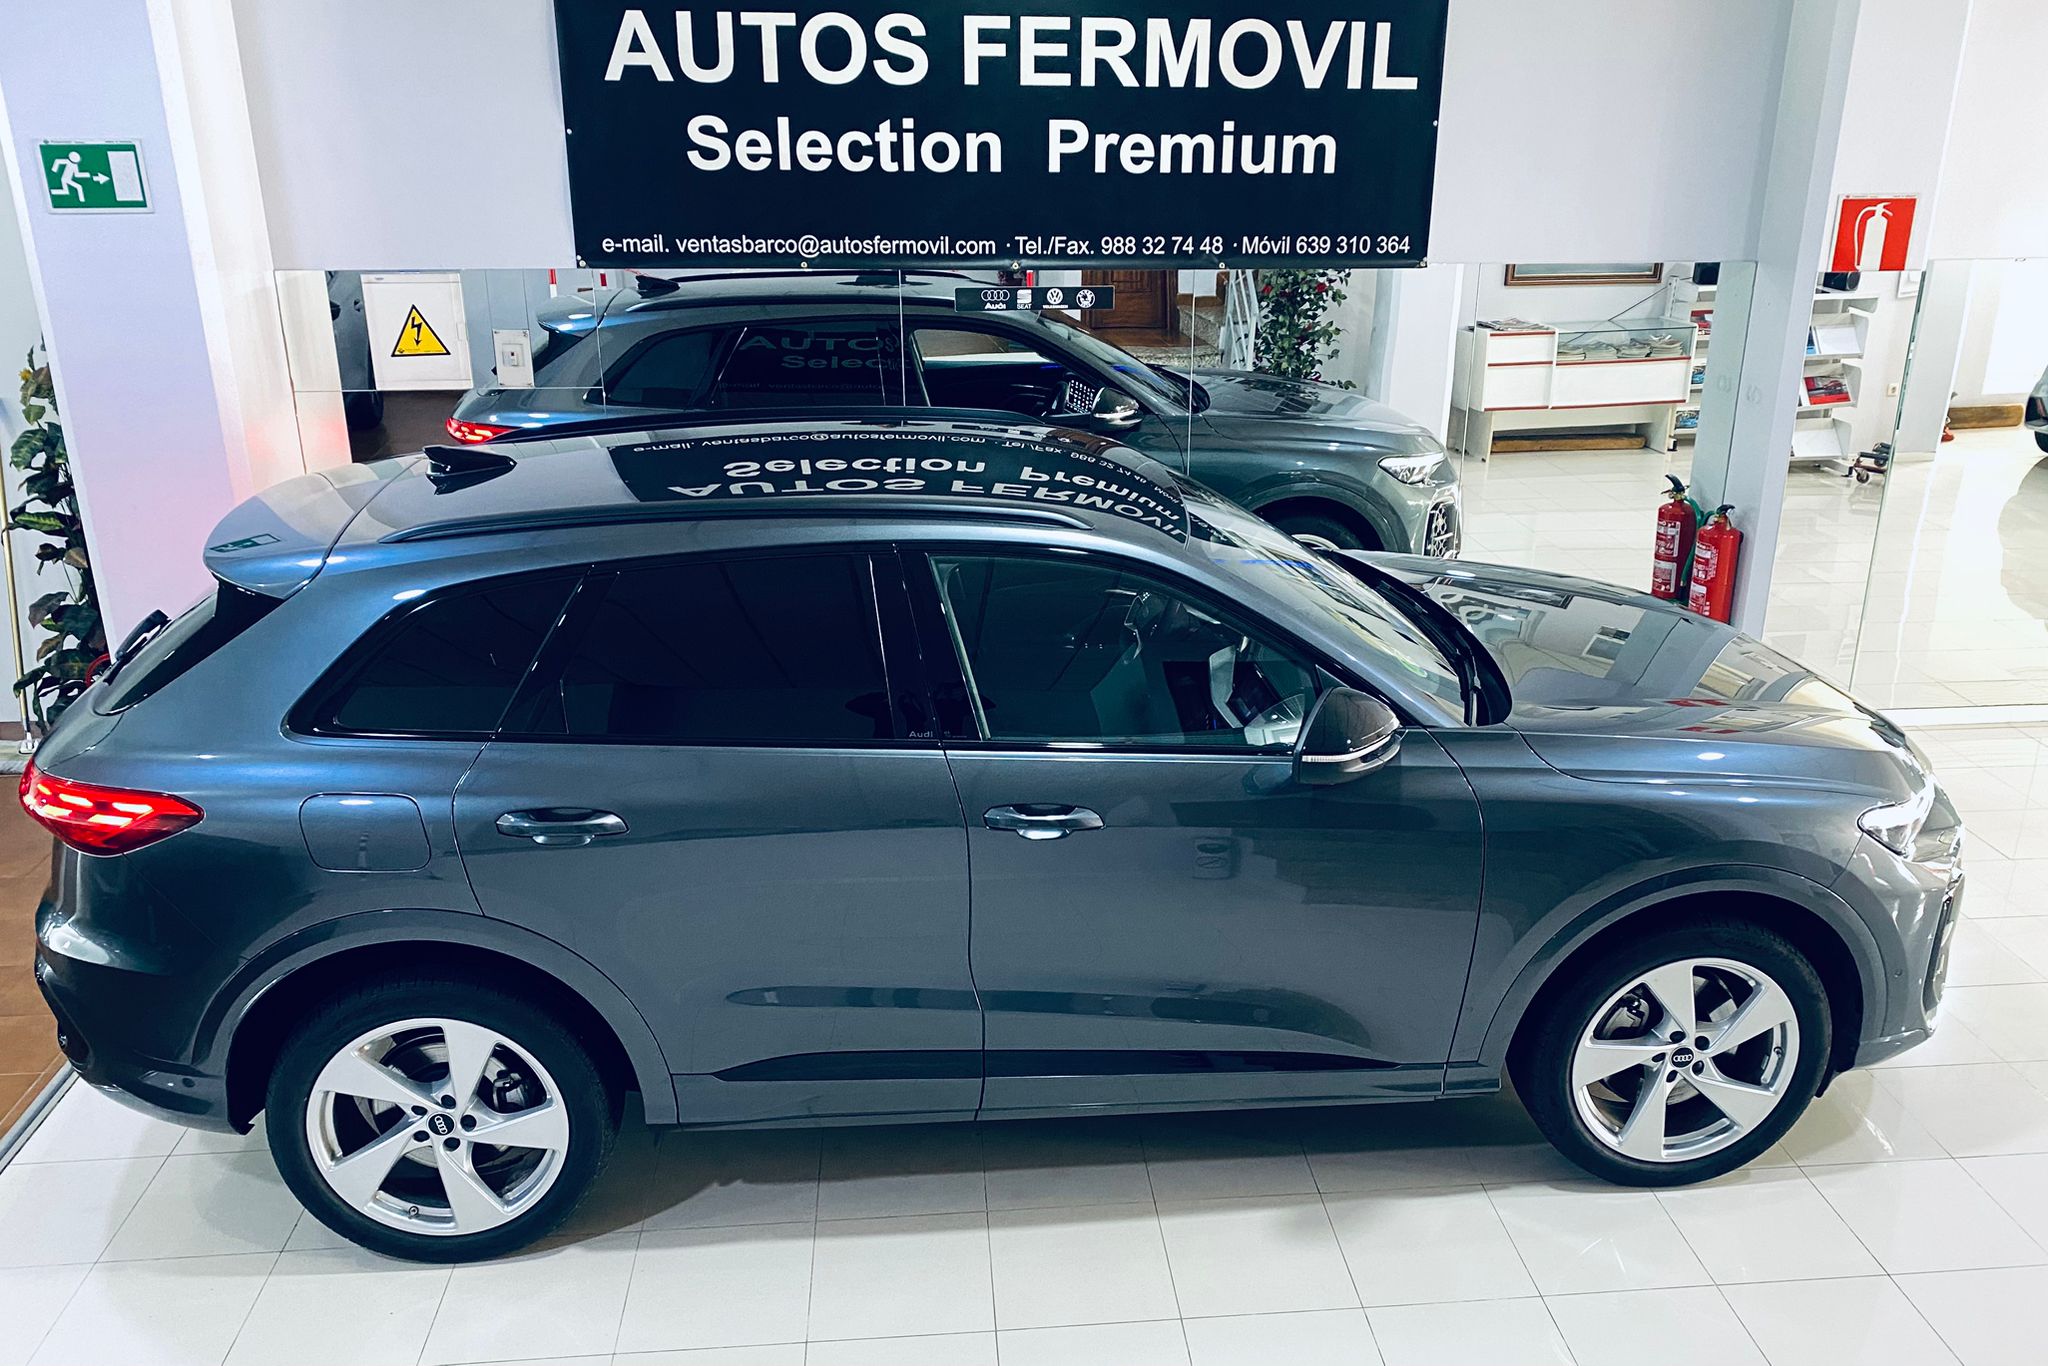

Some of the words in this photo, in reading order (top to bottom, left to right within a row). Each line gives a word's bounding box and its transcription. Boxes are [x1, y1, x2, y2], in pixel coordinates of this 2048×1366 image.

[604, 9, 929, 86] AUTOS
[963, 14, 1419, 90] FERMOVIL
[686, 114, 1002, 173] Selection
[1048, 119, 1337, 175] Premium
[601, 233, 670, 253] e-mail.
[675, 234, 996, 257] ventasbarco@autosfermovil.com
[1015, 235, 1095, 255] Tel./Fax.
[1100, 235, 1137, 255] 988
[1142, 235, 1166, 255] 32
[1171, 235, 1195, 255] 74
[1199, 235, 1224, 255] 48
[1242, 235, 1291, 255] Móvil
[1295, 235, 1331, 255] 639
[1335, 235, 1371, 254] 310
[1376, 235, 1411, 254] 364
[984, 302, 1007, 310] Audi
[908, 730, 934, 738] Audi
